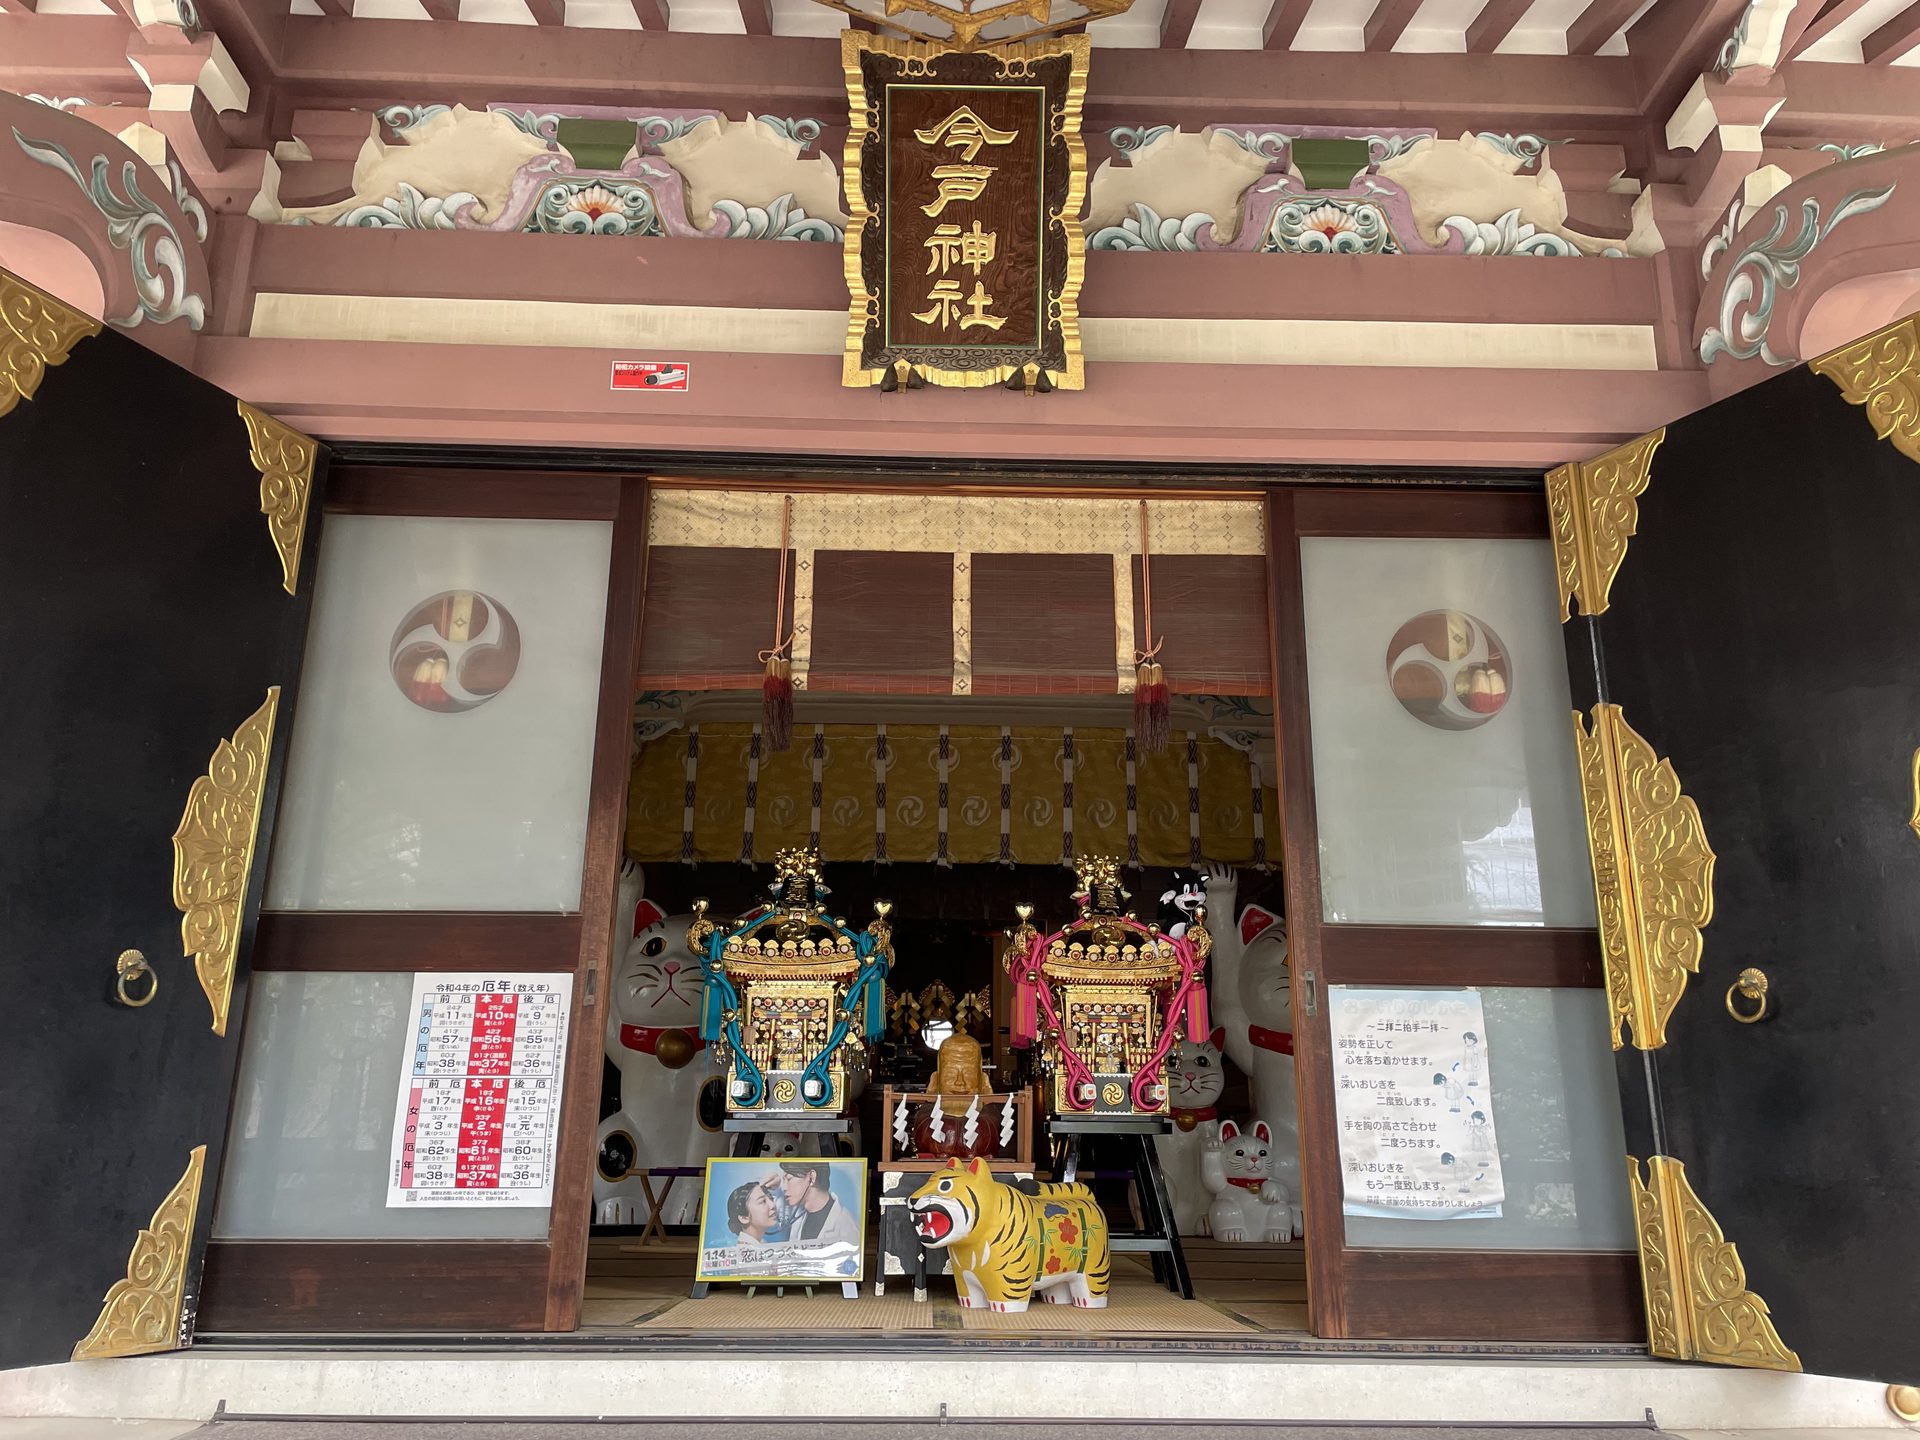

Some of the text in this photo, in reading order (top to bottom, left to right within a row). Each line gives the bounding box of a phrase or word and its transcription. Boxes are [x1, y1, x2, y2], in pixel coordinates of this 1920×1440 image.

[912, 104, 1019, 331] 今戸神社
[1338, 1039, 1393, 1049] 姿勢を正して
[1345, 1056, 1433, 1066] 心を落ち着かせます。
